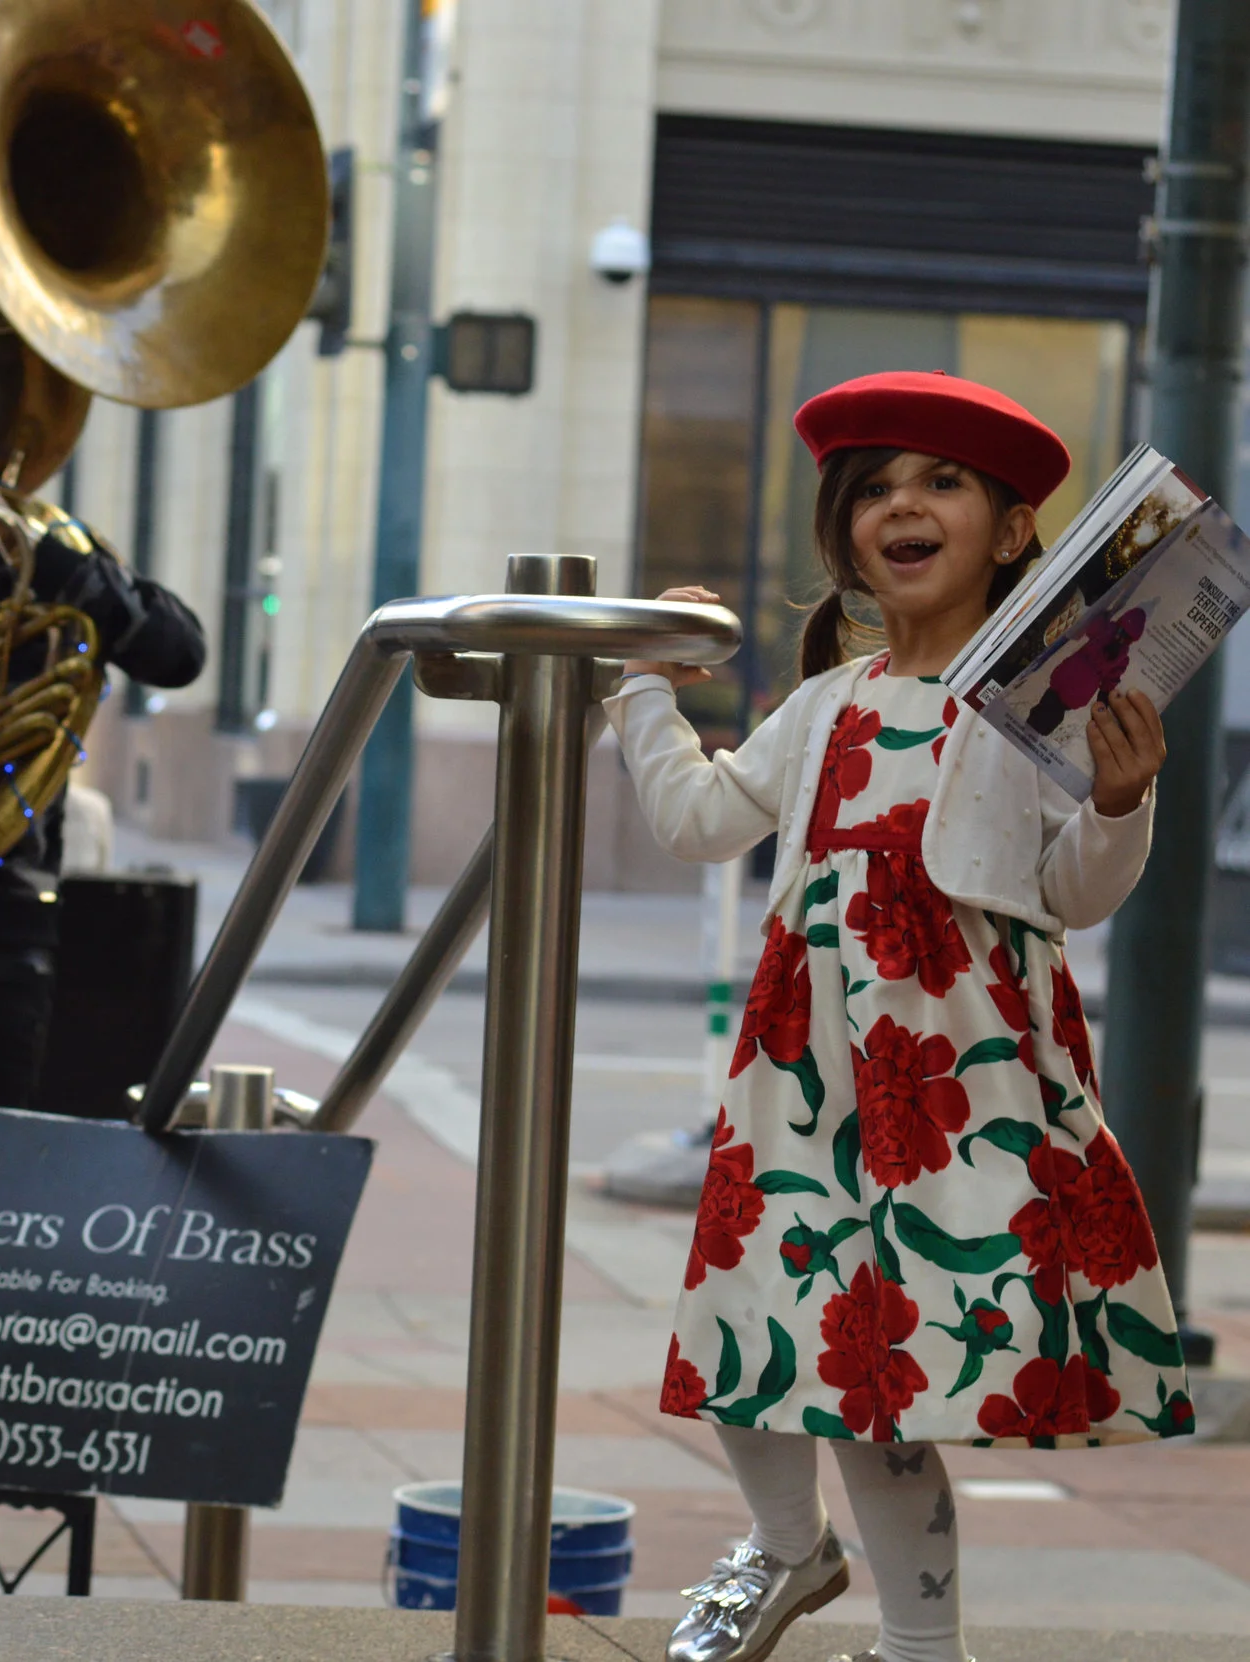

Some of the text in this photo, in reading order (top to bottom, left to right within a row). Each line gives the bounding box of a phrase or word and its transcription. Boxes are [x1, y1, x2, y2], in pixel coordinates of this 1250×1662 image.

[1193, 591, 1232, 628] FERTILITY
[1198, 575, 1240, 618] CONSULT THE
[1187, 606, 1221, 640] EXPERTS
[82, 1203, 171, 1257] Of
[167, 1209, 317, 1268] Brass
[46, 1270, 83, 1295] For
